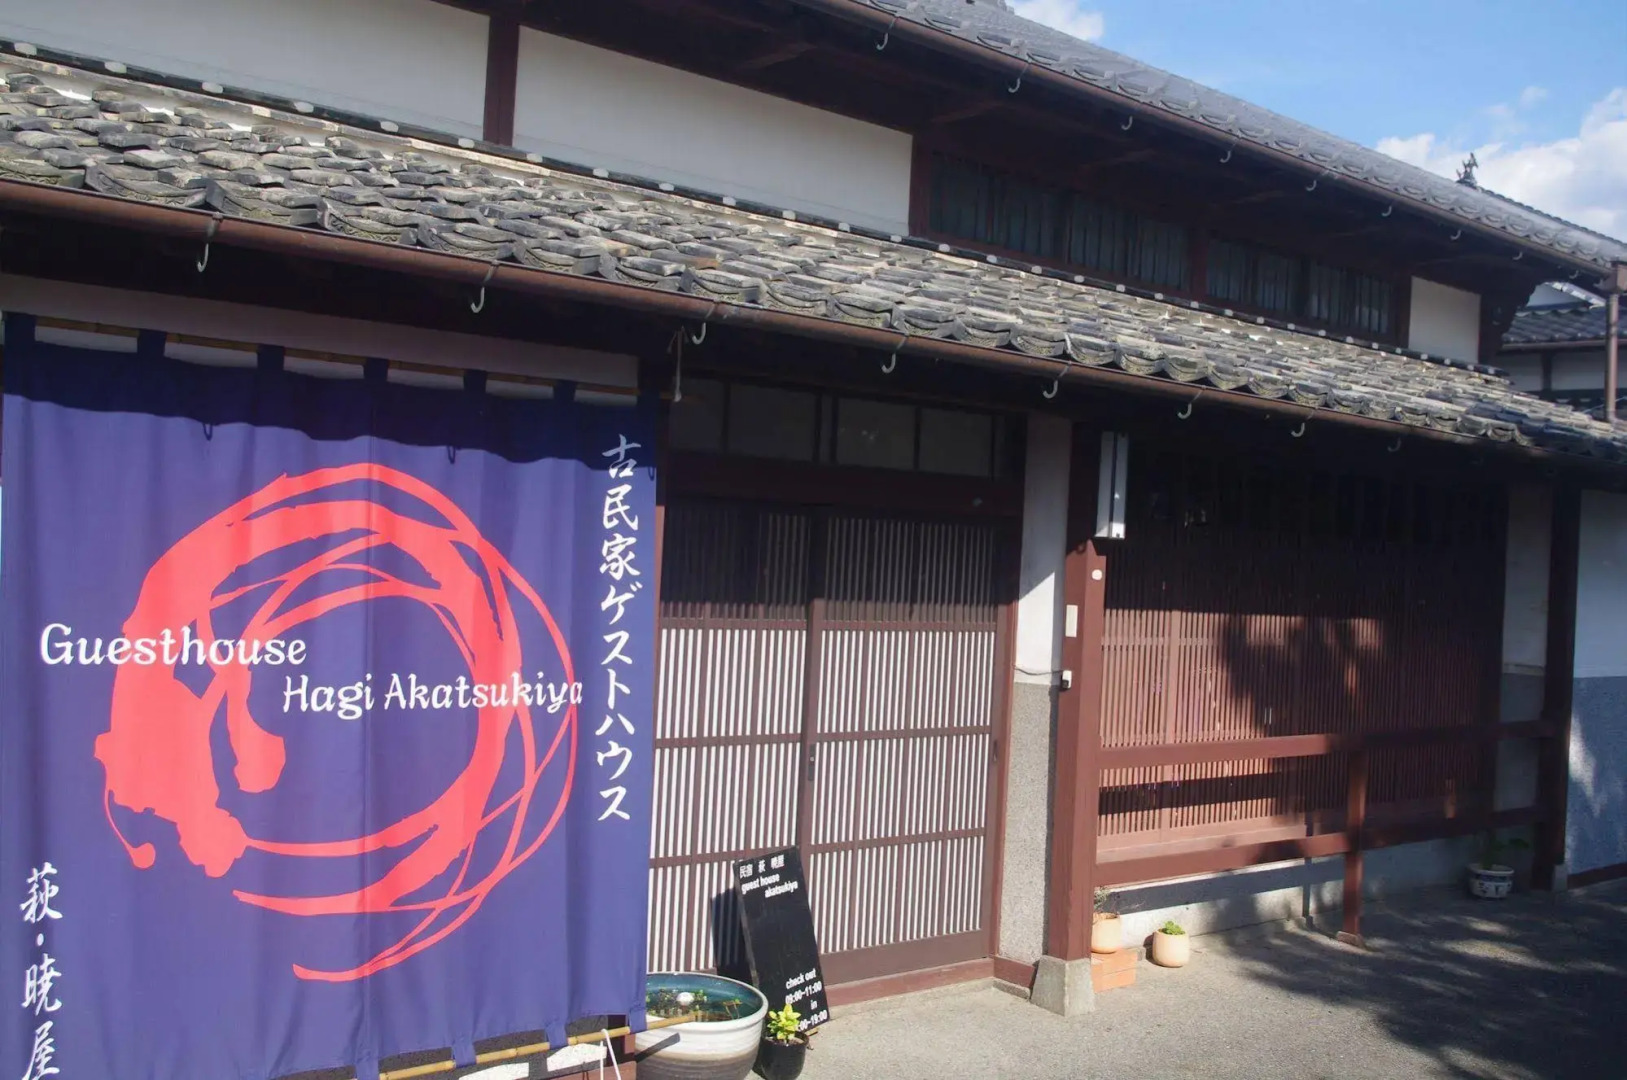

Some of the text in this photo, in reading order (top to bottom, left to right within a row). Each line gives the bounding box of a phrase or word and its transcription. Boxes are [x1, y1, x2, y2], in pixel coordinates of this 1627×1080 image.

[595, 433, 643, 821] 古民家ゲストハウス
[40, 622, 308, 667] Guesthouse
[283, 671, 584, 720] Hagi Akatsukiya
[741, 873, 780, 895] guest house
[785, 968, 817, 990] check out
[810, 1000, 818, 1010] in
